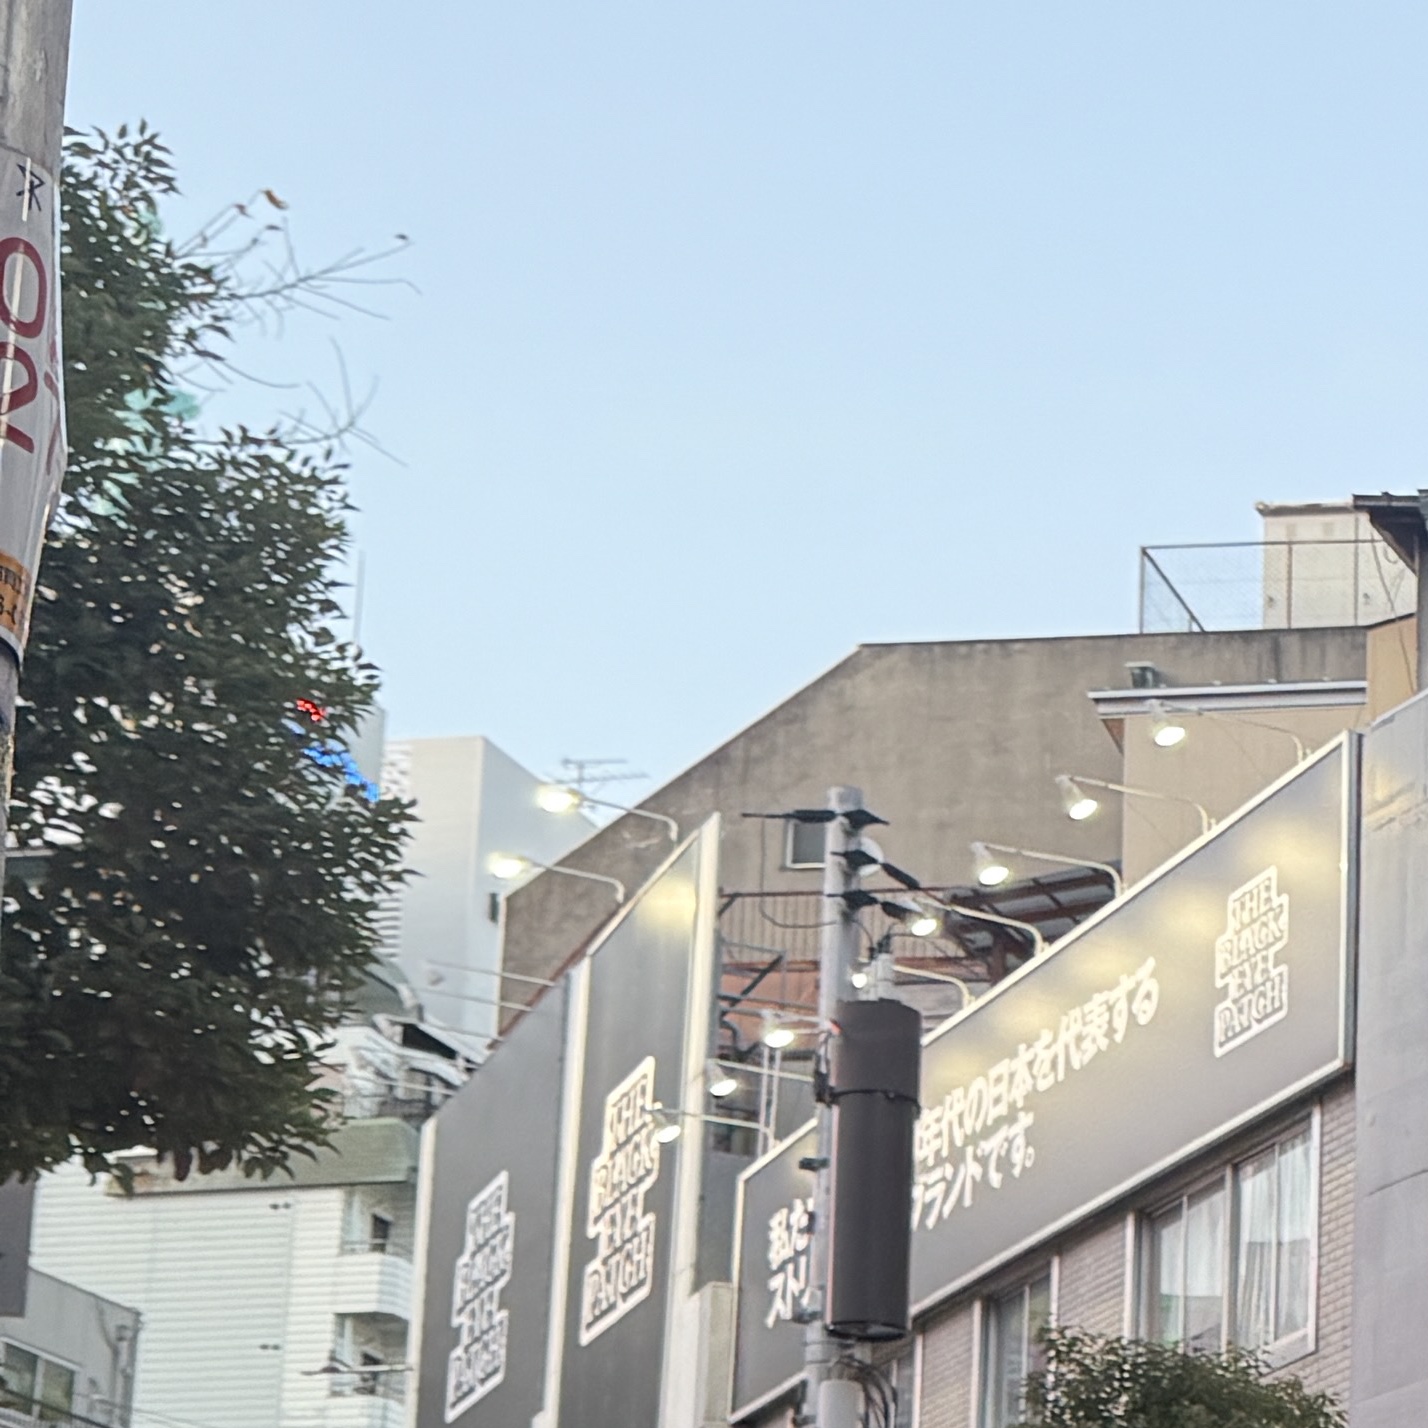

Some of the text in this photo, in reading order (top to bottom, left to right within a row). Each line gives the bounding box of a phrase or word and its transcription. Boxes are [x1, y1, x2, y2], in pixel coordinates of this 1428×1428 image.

[1232, 877, 1272, 932] THE
[1220, 903, 1284, 977] BLACK
[1218, 974, 1283, 1044] PATCH
[1231, 951, 1270, 1001] EYE
[914, 956, 1158, 1167] 年代の日本を代表する
